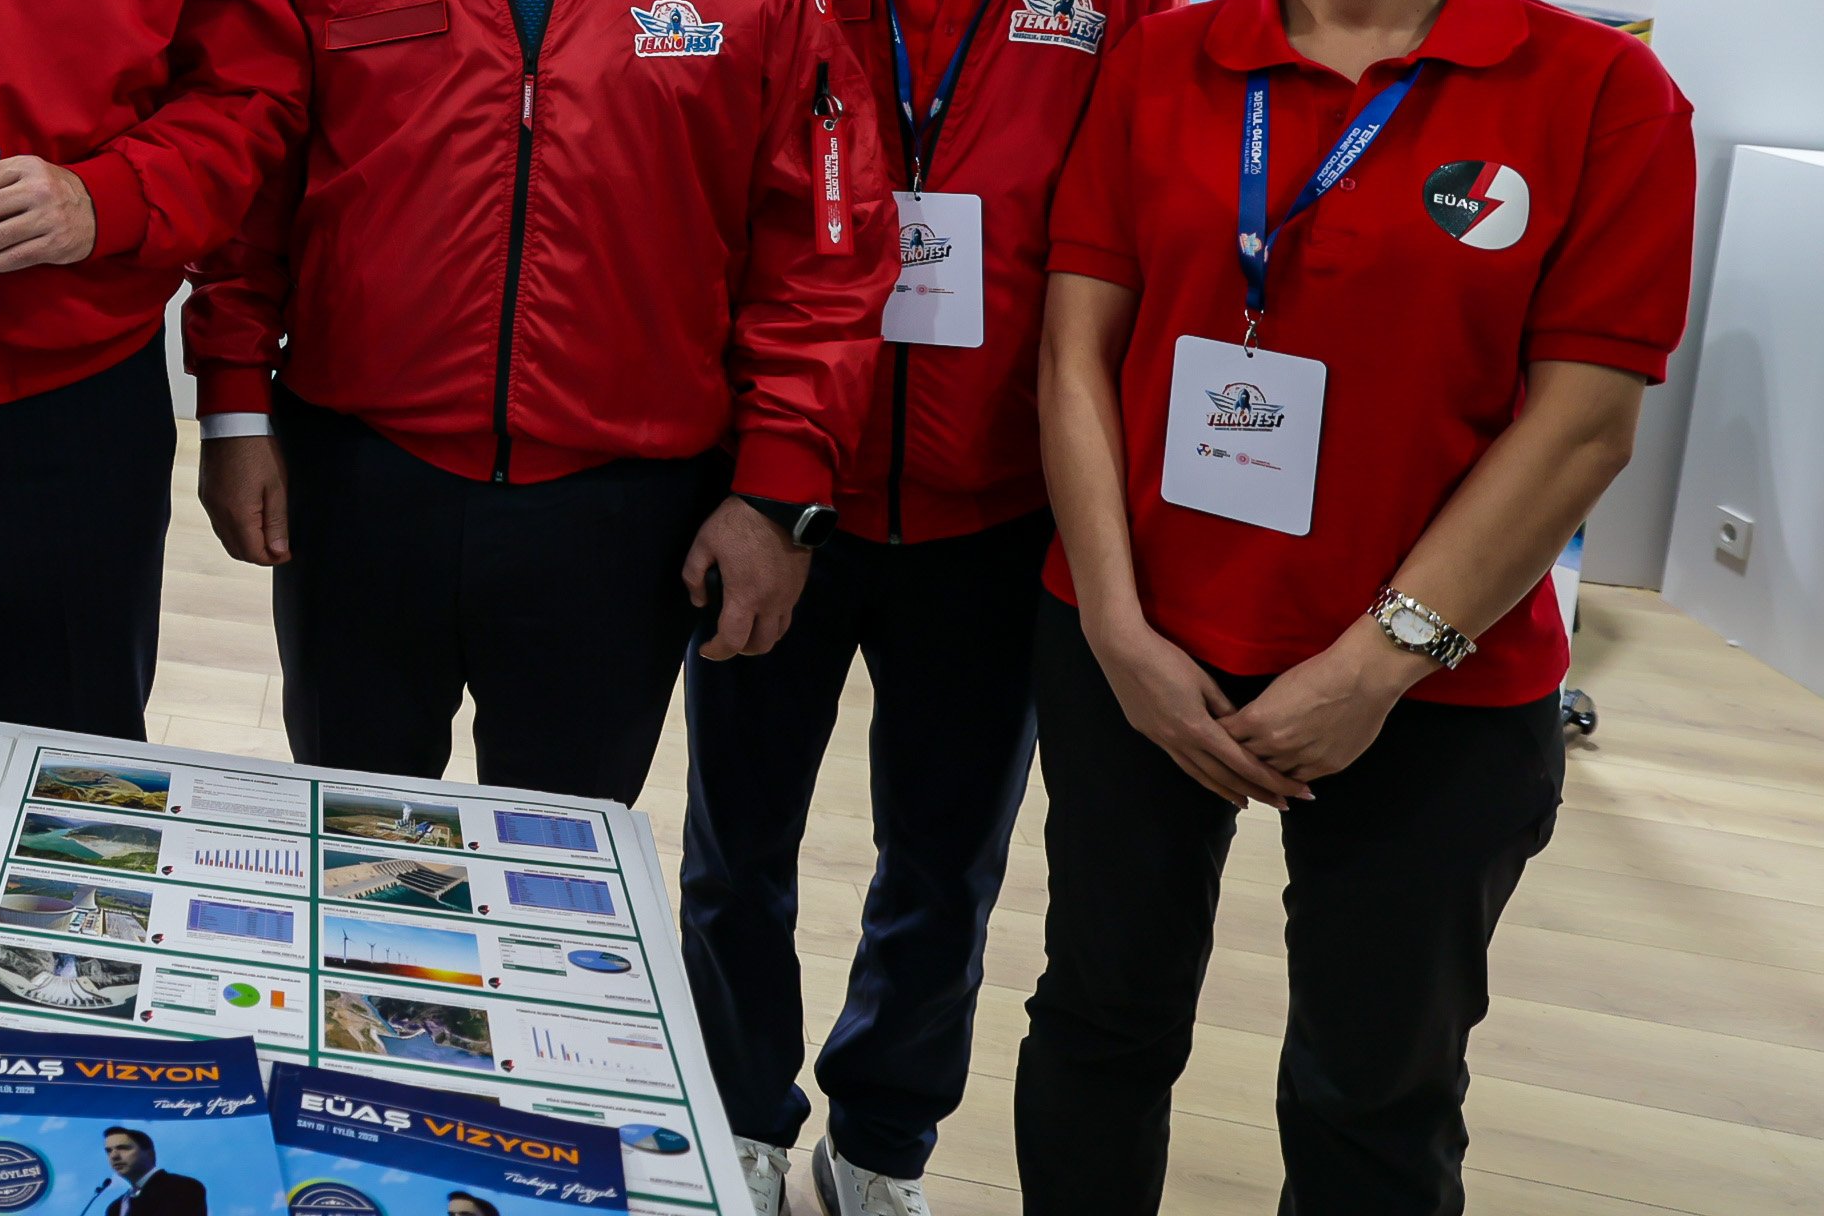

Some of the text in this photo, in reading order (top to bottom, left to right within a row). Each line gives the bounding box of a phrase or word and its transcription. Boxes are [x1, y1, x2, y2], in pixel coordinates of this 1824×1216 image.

[1016, 14, 1100, 39] TEKNOFEST
[637, 35, 720, 54] TEKNOFEST
[1316, 123, 1380, 196] TEKNOFEST
[1433, 193, 1480, 213] EÜAŞ
[901, 245, 952, 263] KNOFEST
[1207, 413, 1284, 428] TEKNOFEST
[75, 1060, 220, 1082] VİZYON
[153, 1098, 202, 1116] Türkiye
[296, 1119, 315, 1130] SAYI
[332, 1125, 356, 1139] EYLÜL
[300, 1093, 579, 1164] EÜAŞ VİZYON
[504, 1171, 558, 1194] Türkiye
